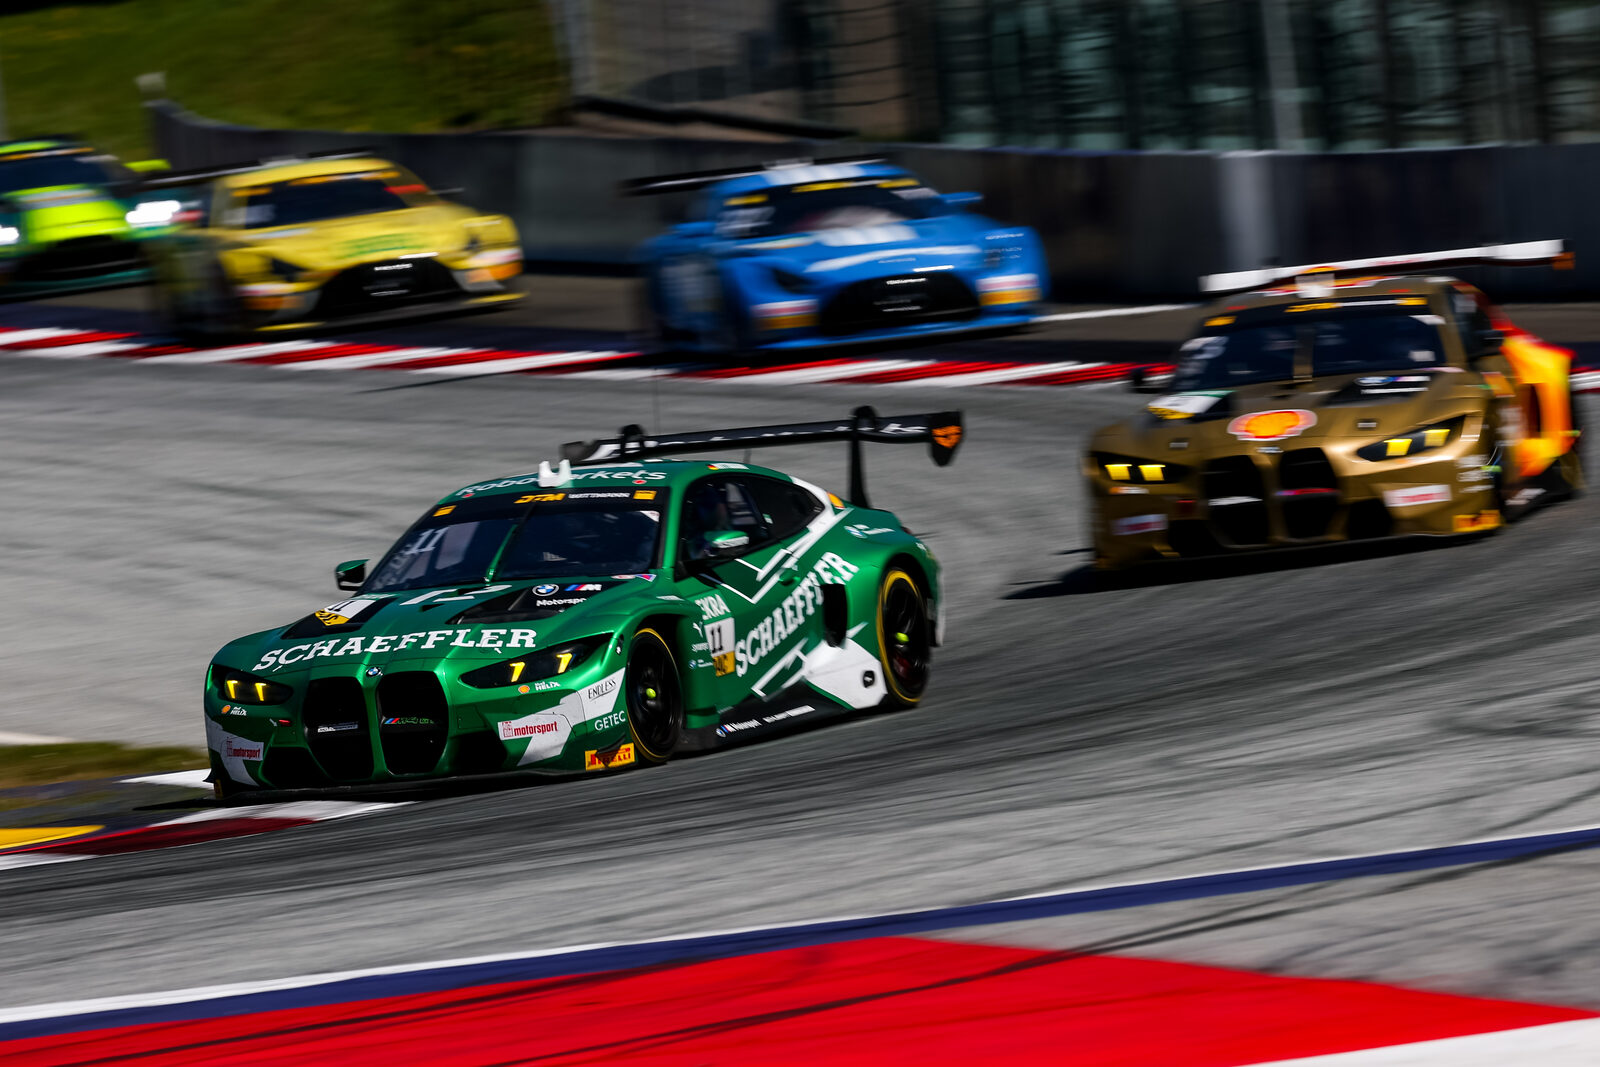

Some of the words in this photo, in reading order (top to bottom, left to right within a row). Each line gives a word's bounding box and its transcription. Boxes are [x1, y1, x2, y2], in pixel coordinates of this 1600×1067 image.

[711, 625, 724, 653] 11
[251, 629, 537, 671] SCHAEFFLER
[588, 679, 616, 699] ENDLESS
[514, 721, 558, 736] motorsport
[594, 710, 626, 731] GETEC
[232, 747, 261, 759] motorsport
